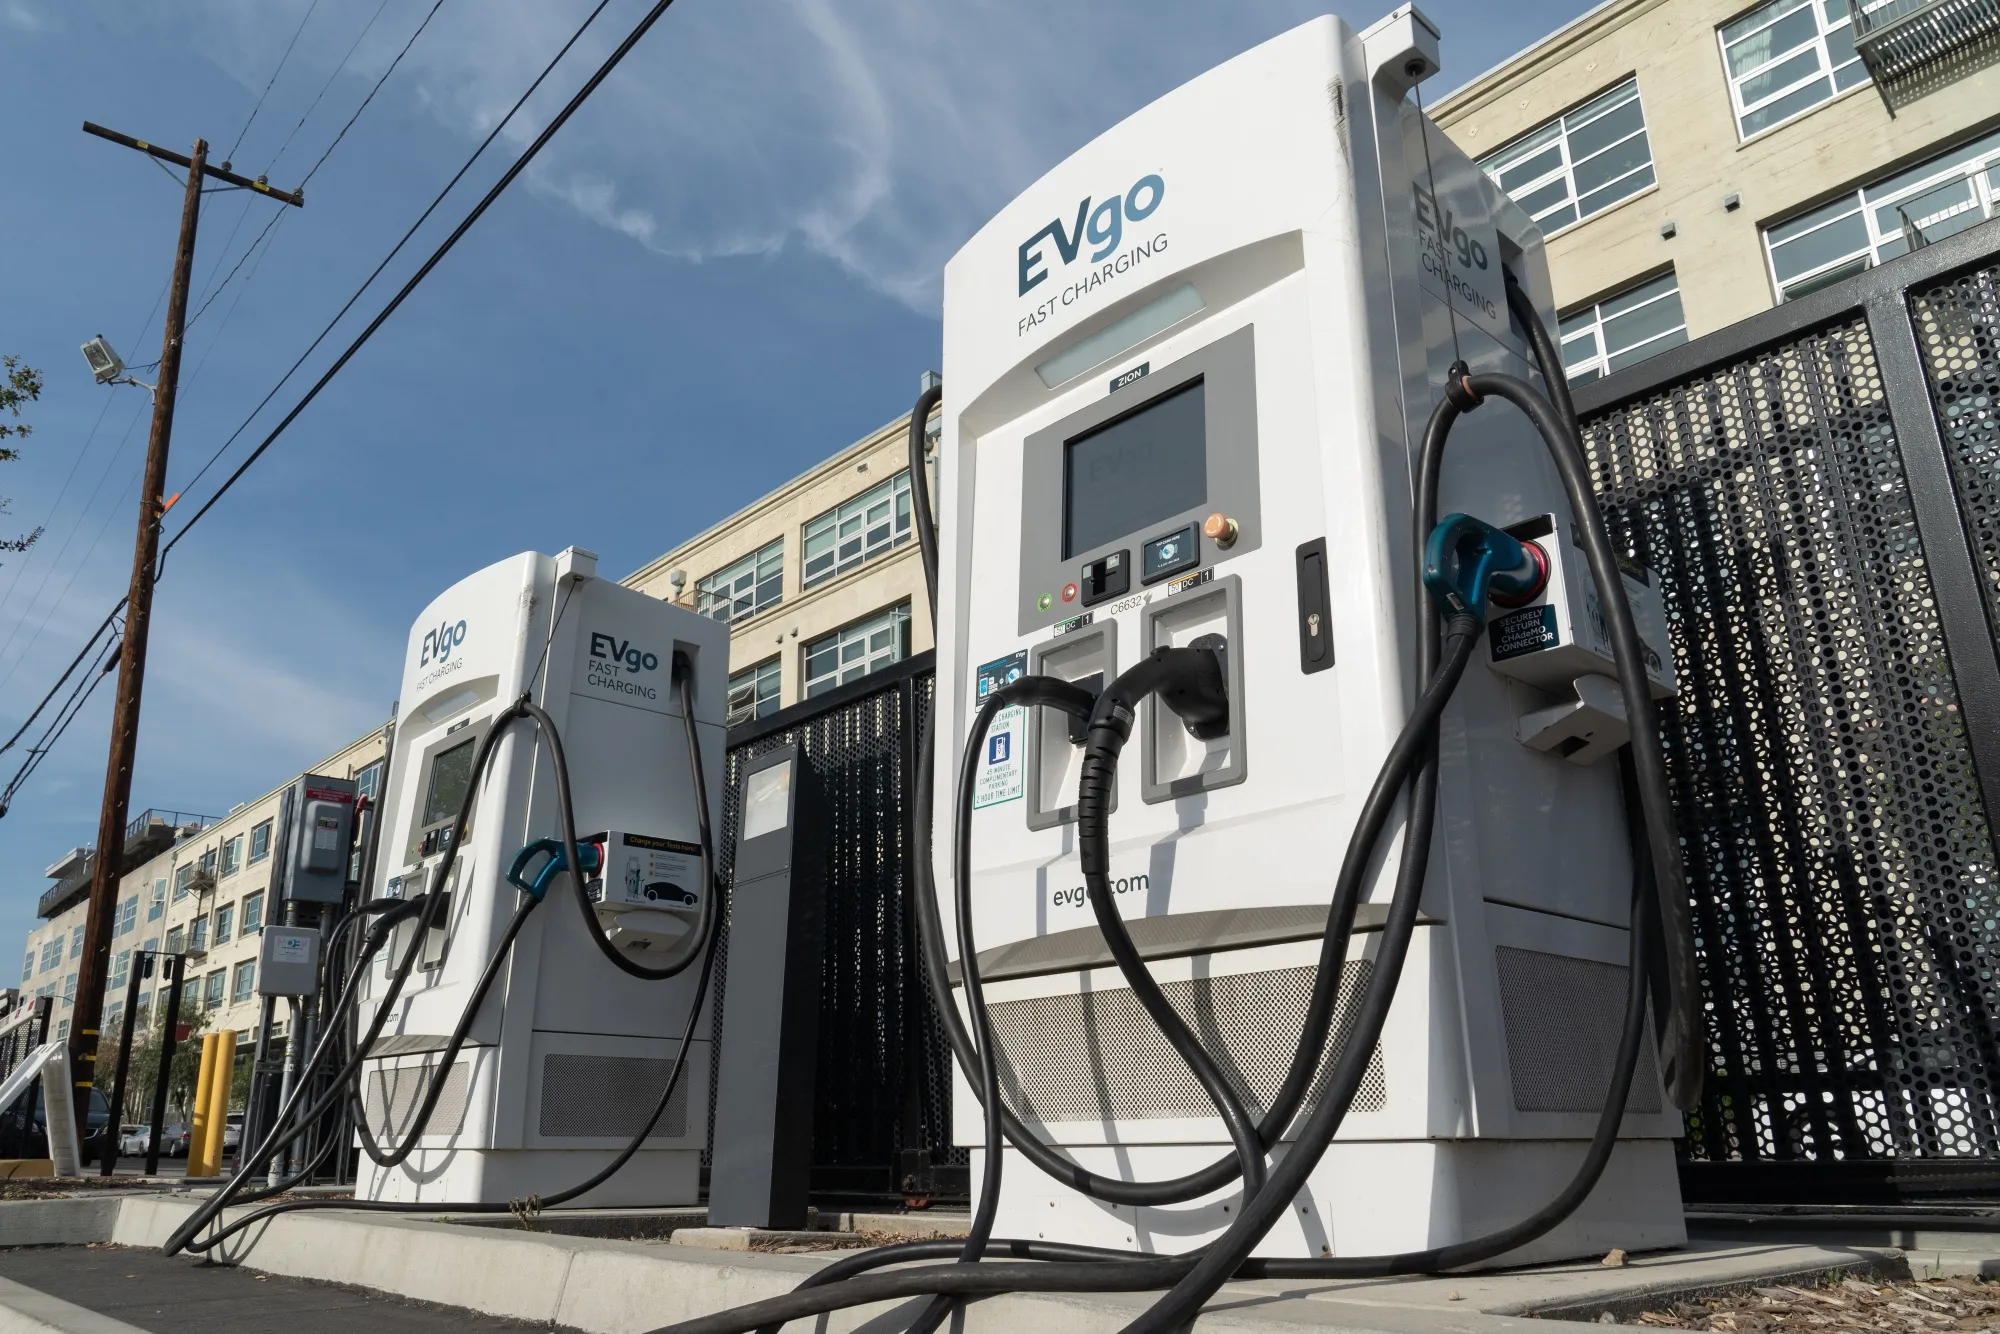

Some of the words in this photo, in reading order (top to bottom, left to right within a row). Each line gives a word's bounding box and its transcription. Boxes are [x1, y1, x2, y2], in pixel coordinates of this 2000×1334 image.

[1413, 181, 1488, 271] EVgo
[1018, 174, 1165, 298] EVgo
[1418, 228, 1452, 267] FAST
[1018, 295, 1058, 337] FAST
[1061, 233, 1168, 306] CHARGING
[1422, 253, 1496, 319] CHARGING
[1118, 368, 1142, 387] ZION
[1182, 577, 1193, 587] DC
[1111, 595, 1141, 615] C6632
[1065, 620, 1076, 630] DC
[1500, 608, 1543, 627] SECURELY
[1505, 618, 1541, 634] RETURN
[1496, 632, 1554, 653] CONNECTOR
[1501, 625, 1546, 643] CHAdeMO
[420, 619, 467, 669] EVgo
[590, 631, 658, 673] EVgo
[429, 657, 463, 684] CHARGING
[588, 659, 620, 677] FAST
[587, 673, 656, 700] CHARGING
[999, 707, 1022, 721] CHARGING
[990, 720, 1010, 733] STATION
[979, 769, 1018, 786] COMPLIMENTARY
[994, 764, 1011, 773] MINUTE
[980, 792, 994, 803] HOUR
[995, 788, 1006, 799] TIME
[1007, 784, 1020, 795] LIMIT
[988, 779, 1009, 789] PARKING
[629, 836, 651, 847] Charge
[652, 840, 665, 848] your
[667, 841, 681, 850] Tesla
